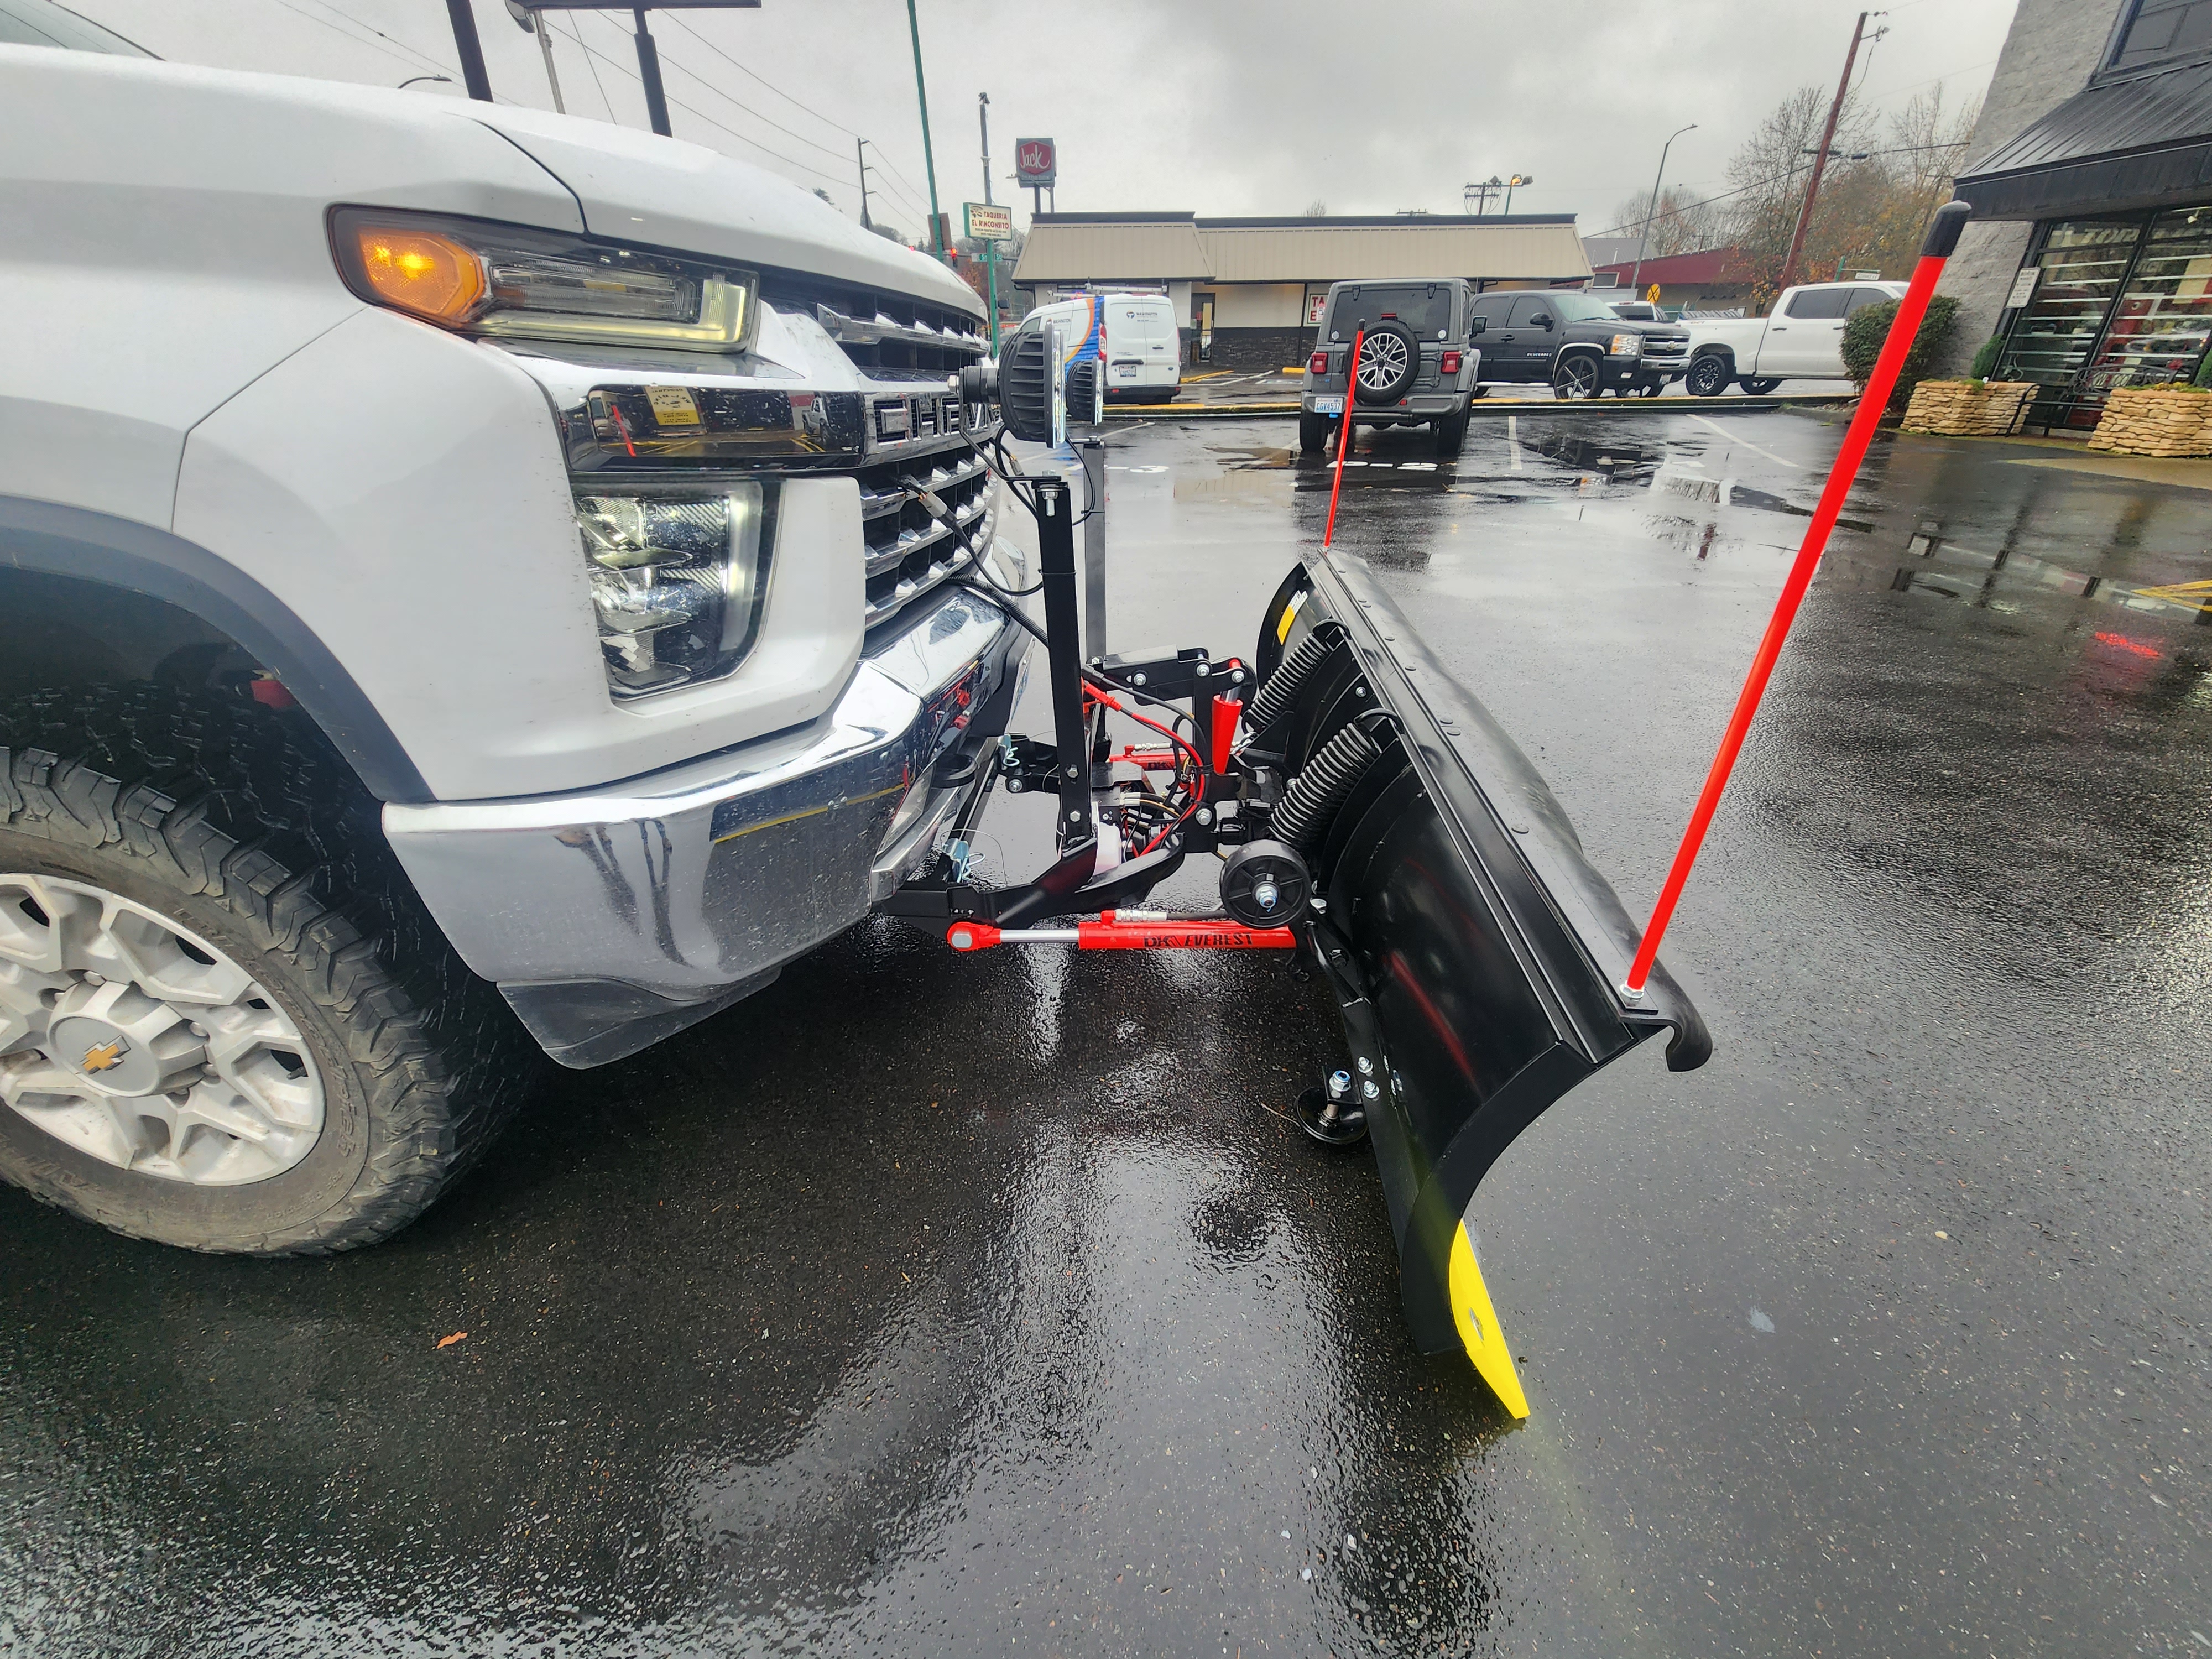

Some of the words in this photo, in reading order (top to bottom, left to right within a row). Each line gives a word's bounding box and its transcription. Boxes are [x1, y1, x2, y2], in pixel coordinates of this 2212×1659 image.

[1020, 144, 1050, 169] Jack
[983, 211, 1008, 220] TAQUERIA
[979, 220, 1009, 229] RINCONSITO
[1185, 932, 1254, 947] EVEREST
